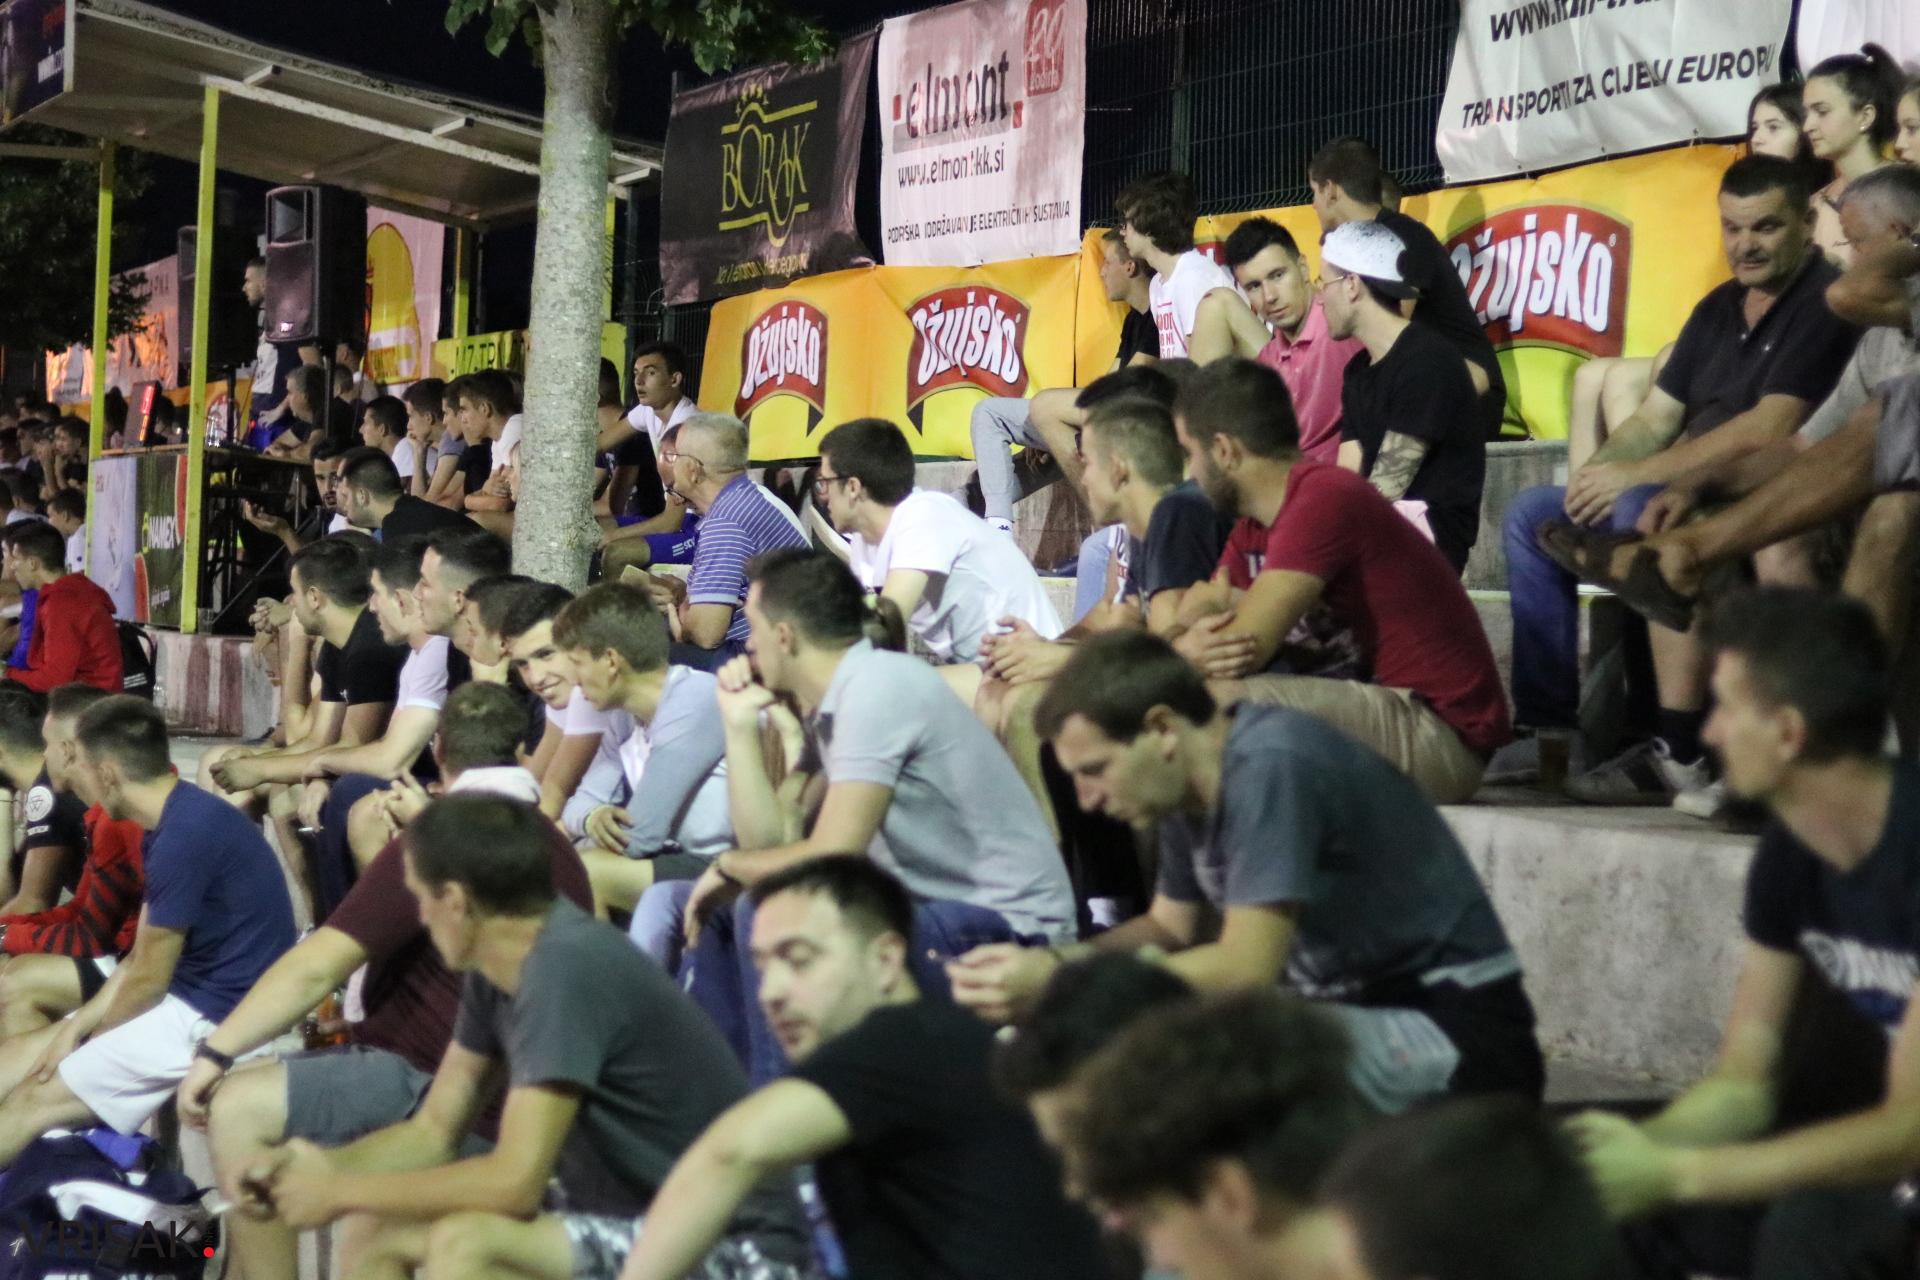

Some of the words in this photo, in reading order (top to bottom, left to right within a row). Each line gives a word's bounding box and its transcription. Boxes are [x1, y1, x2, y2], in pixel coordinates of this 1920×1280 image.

[905, 50, 1009, 138] elmont
[1573, 73, 1597, 105] ZA
[721, 121, 811, 226] BORAK
[1033, 200, 1070, 223] SUSTAVA
[741, 305, 820, 400] Ožujsko
[912, 291, 1020, 386] Ožujsko
